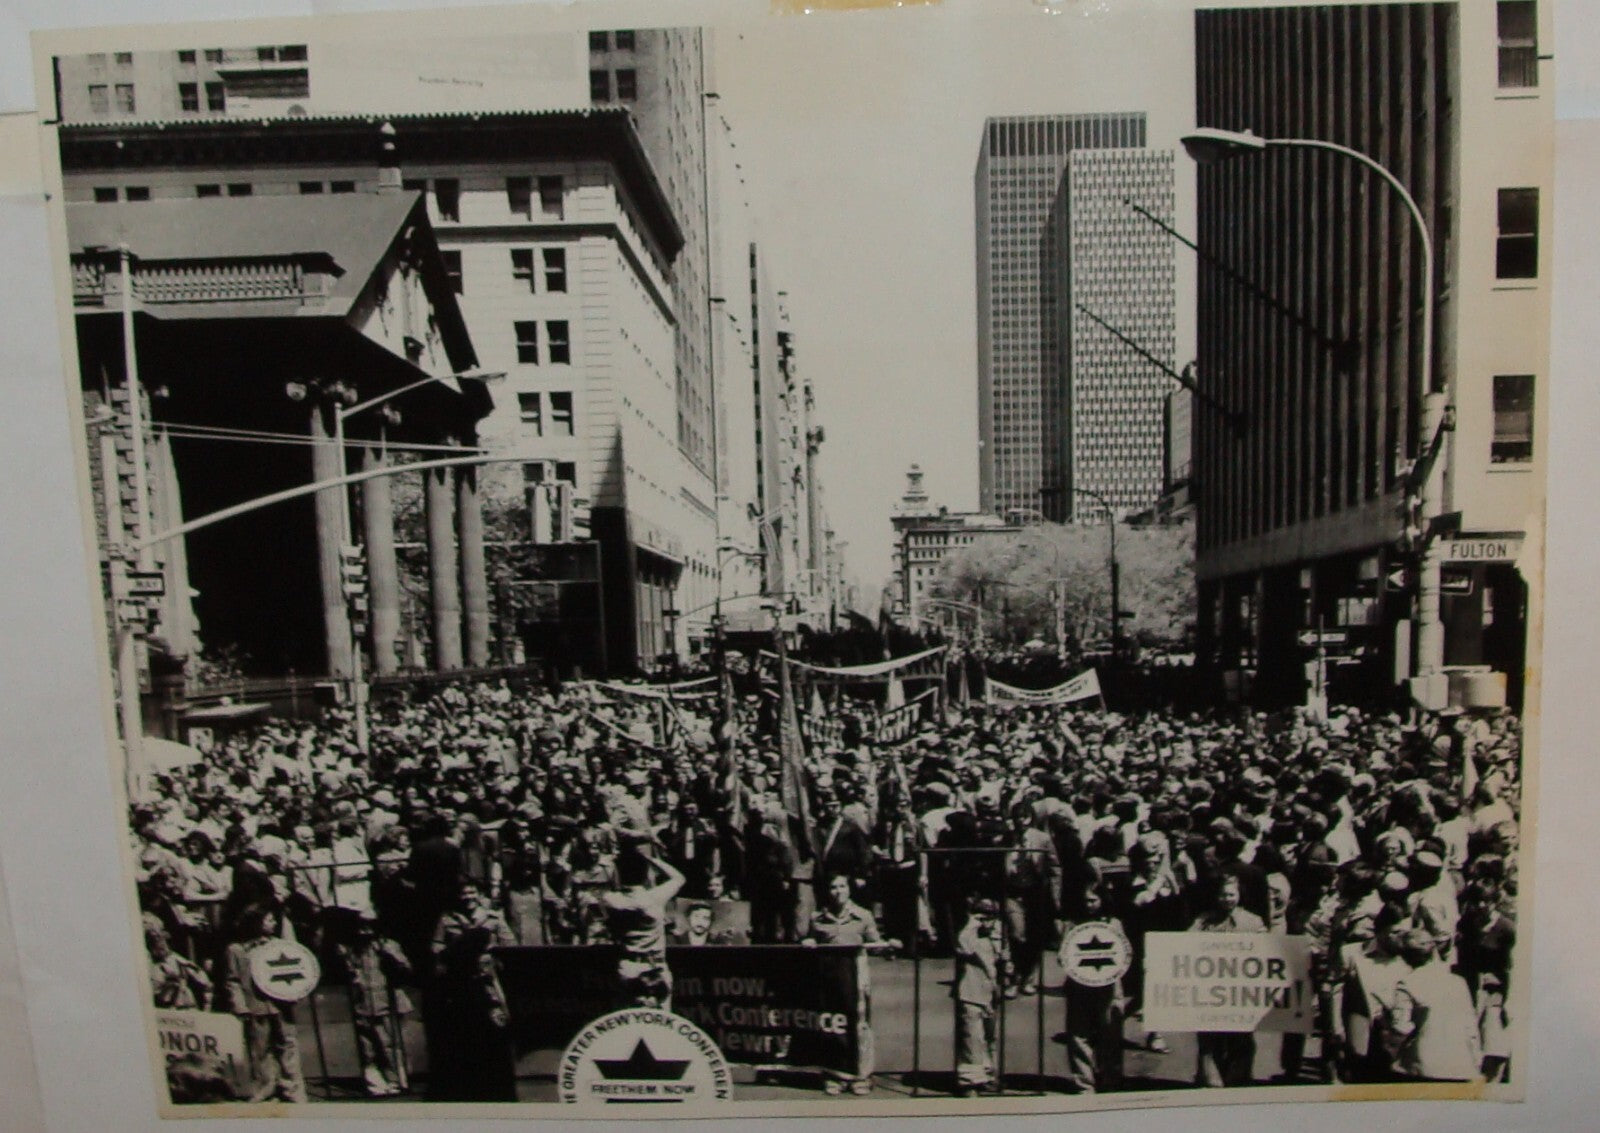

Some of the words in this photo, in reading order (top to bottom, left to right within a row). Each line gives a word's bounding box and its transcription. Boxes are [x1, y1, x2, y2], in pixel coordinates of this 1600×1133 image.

[1450, 542, 1507, 559] FULTON
[1171, 954, 1287, 980] HONOR
[712, 976, 776, 998] now.
[1152, 979, 1304, 1019] HELSINKI!
[717, 1001, 848, 1035] Conference
[562, 1030, 598, 1090] GREATER
[594, 1013, 631, 1035] NEW
[631, 1011, 677, 1030] YORK
[662, 1085, 696, 1095] NOW
